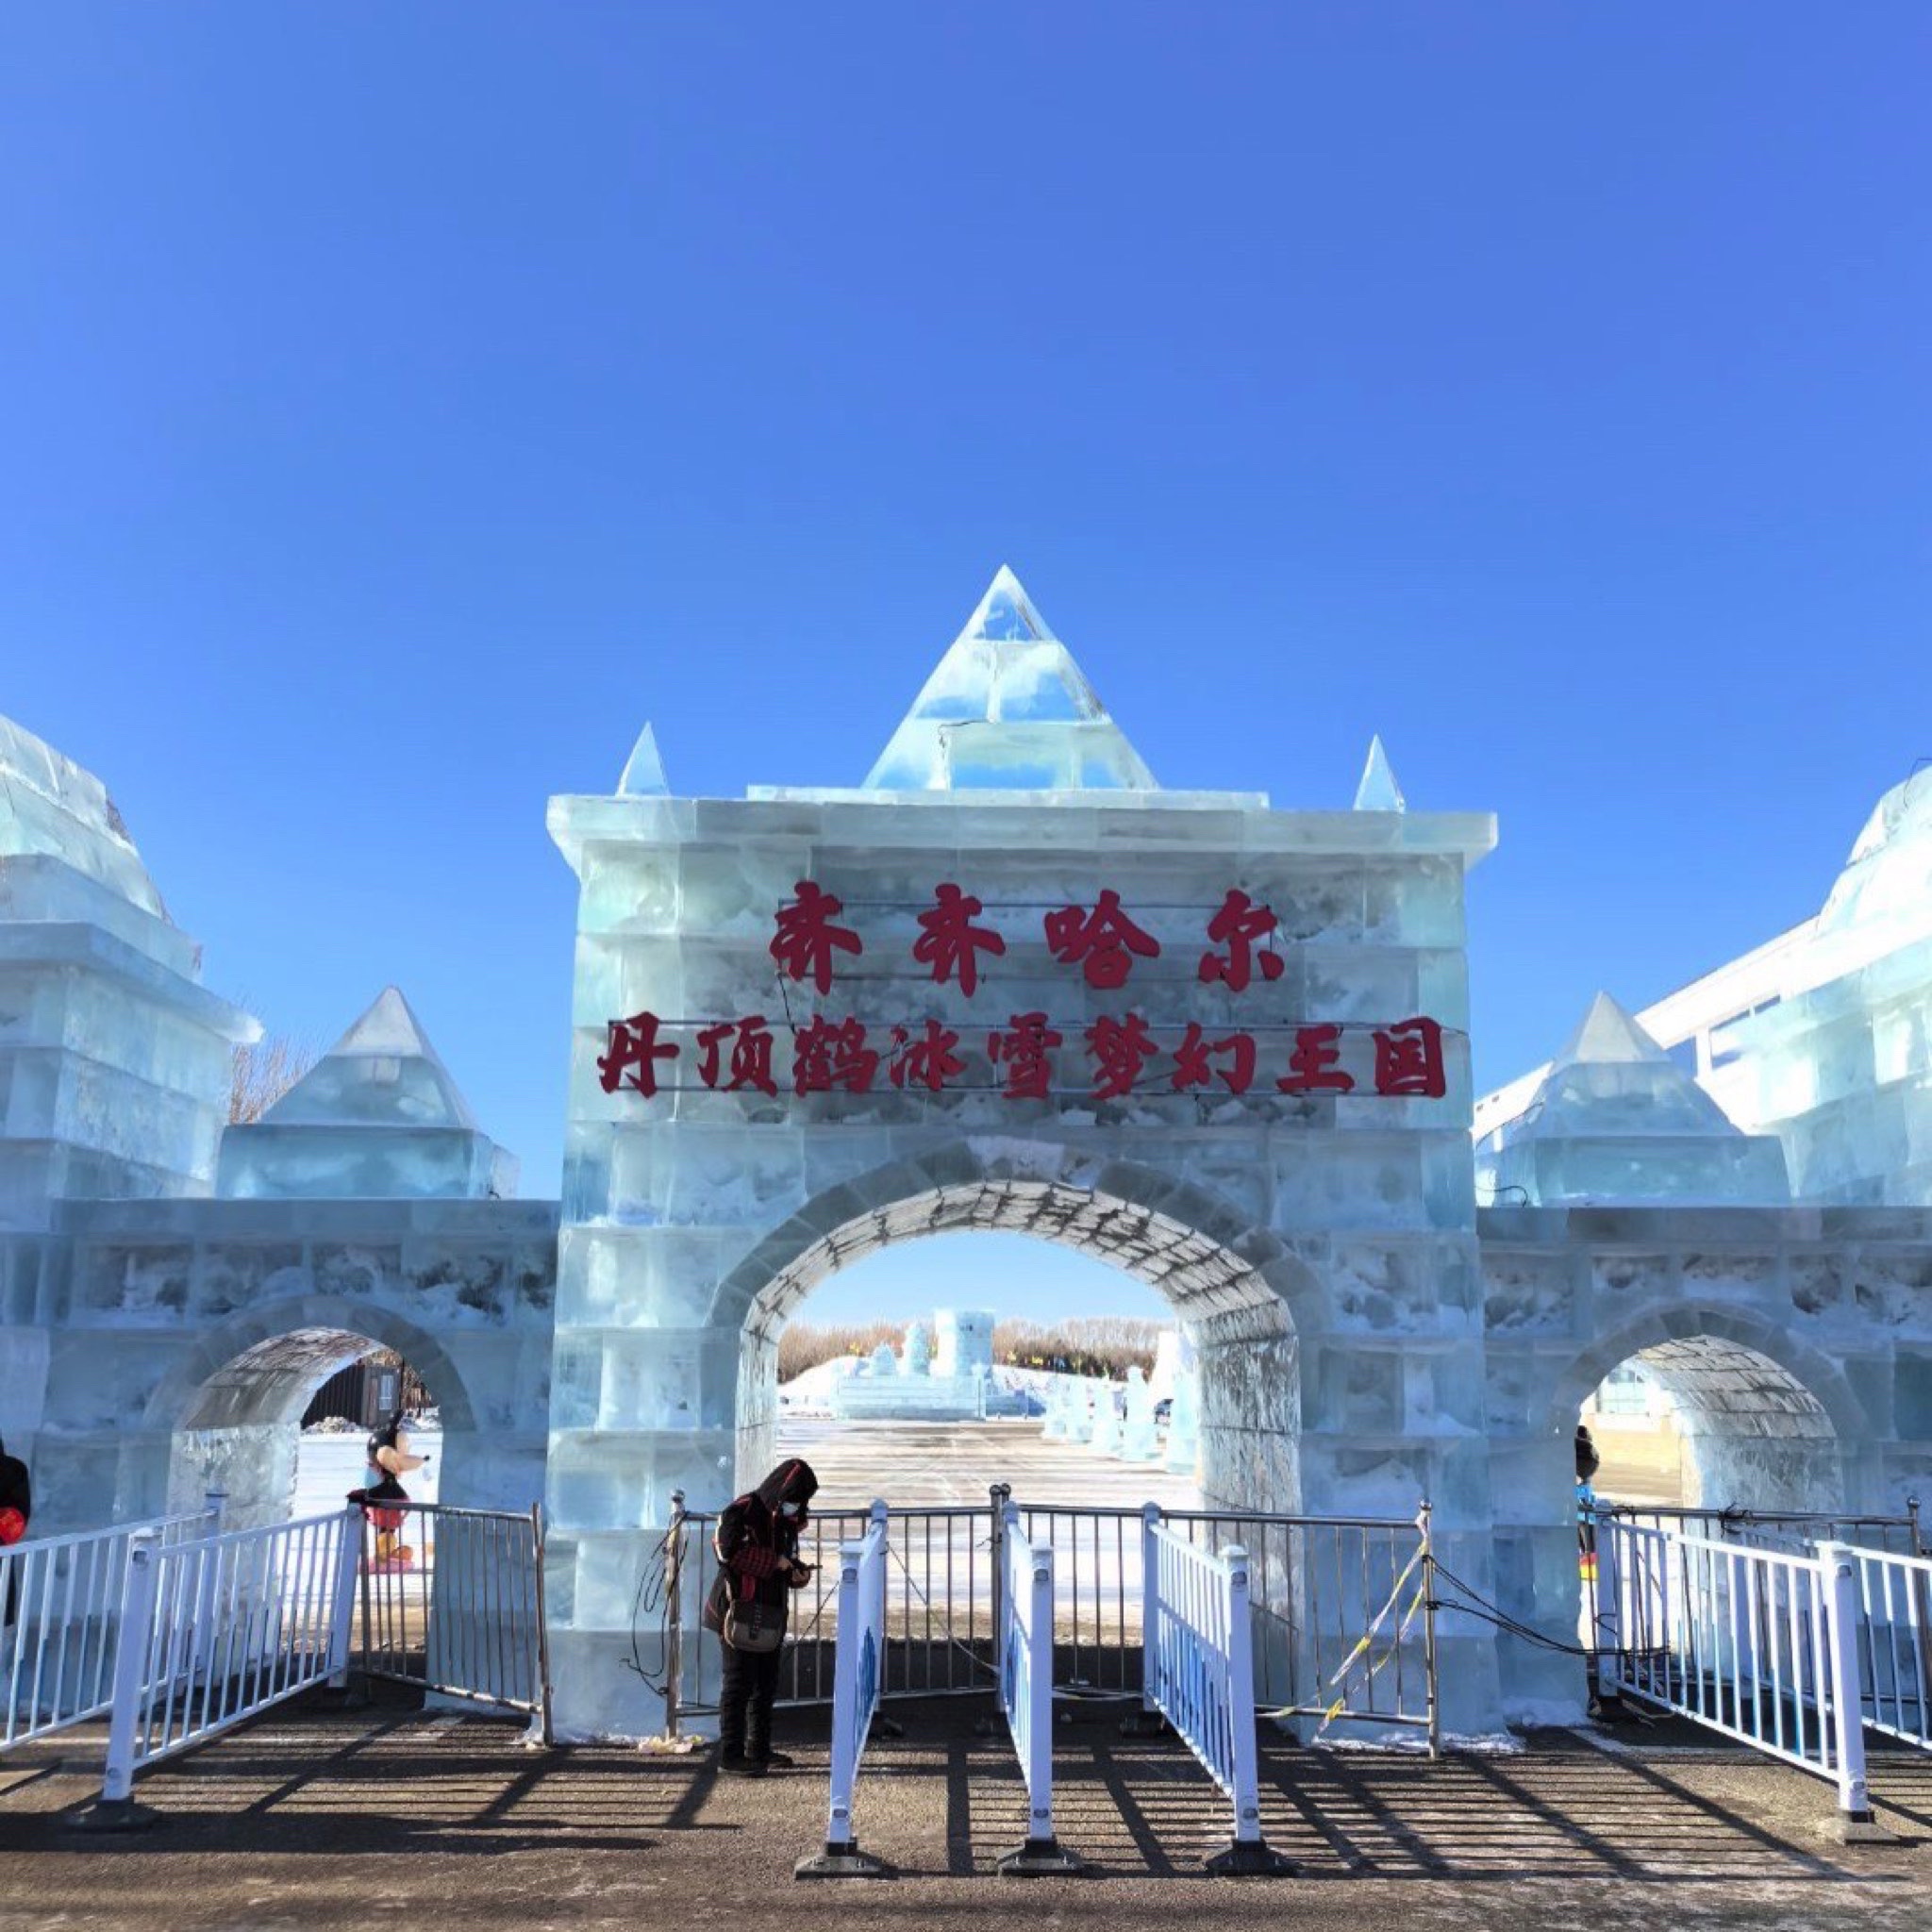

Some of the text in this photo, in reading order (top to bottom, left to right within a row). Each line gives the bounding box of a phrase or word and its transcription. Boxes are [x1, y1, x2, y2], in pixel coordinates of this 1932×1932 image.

[770, 881, 1284, 997] 齐齐哈尔
[597, 1011, 1445, 1099] 丹顶鹤冰雪梦幻王国
